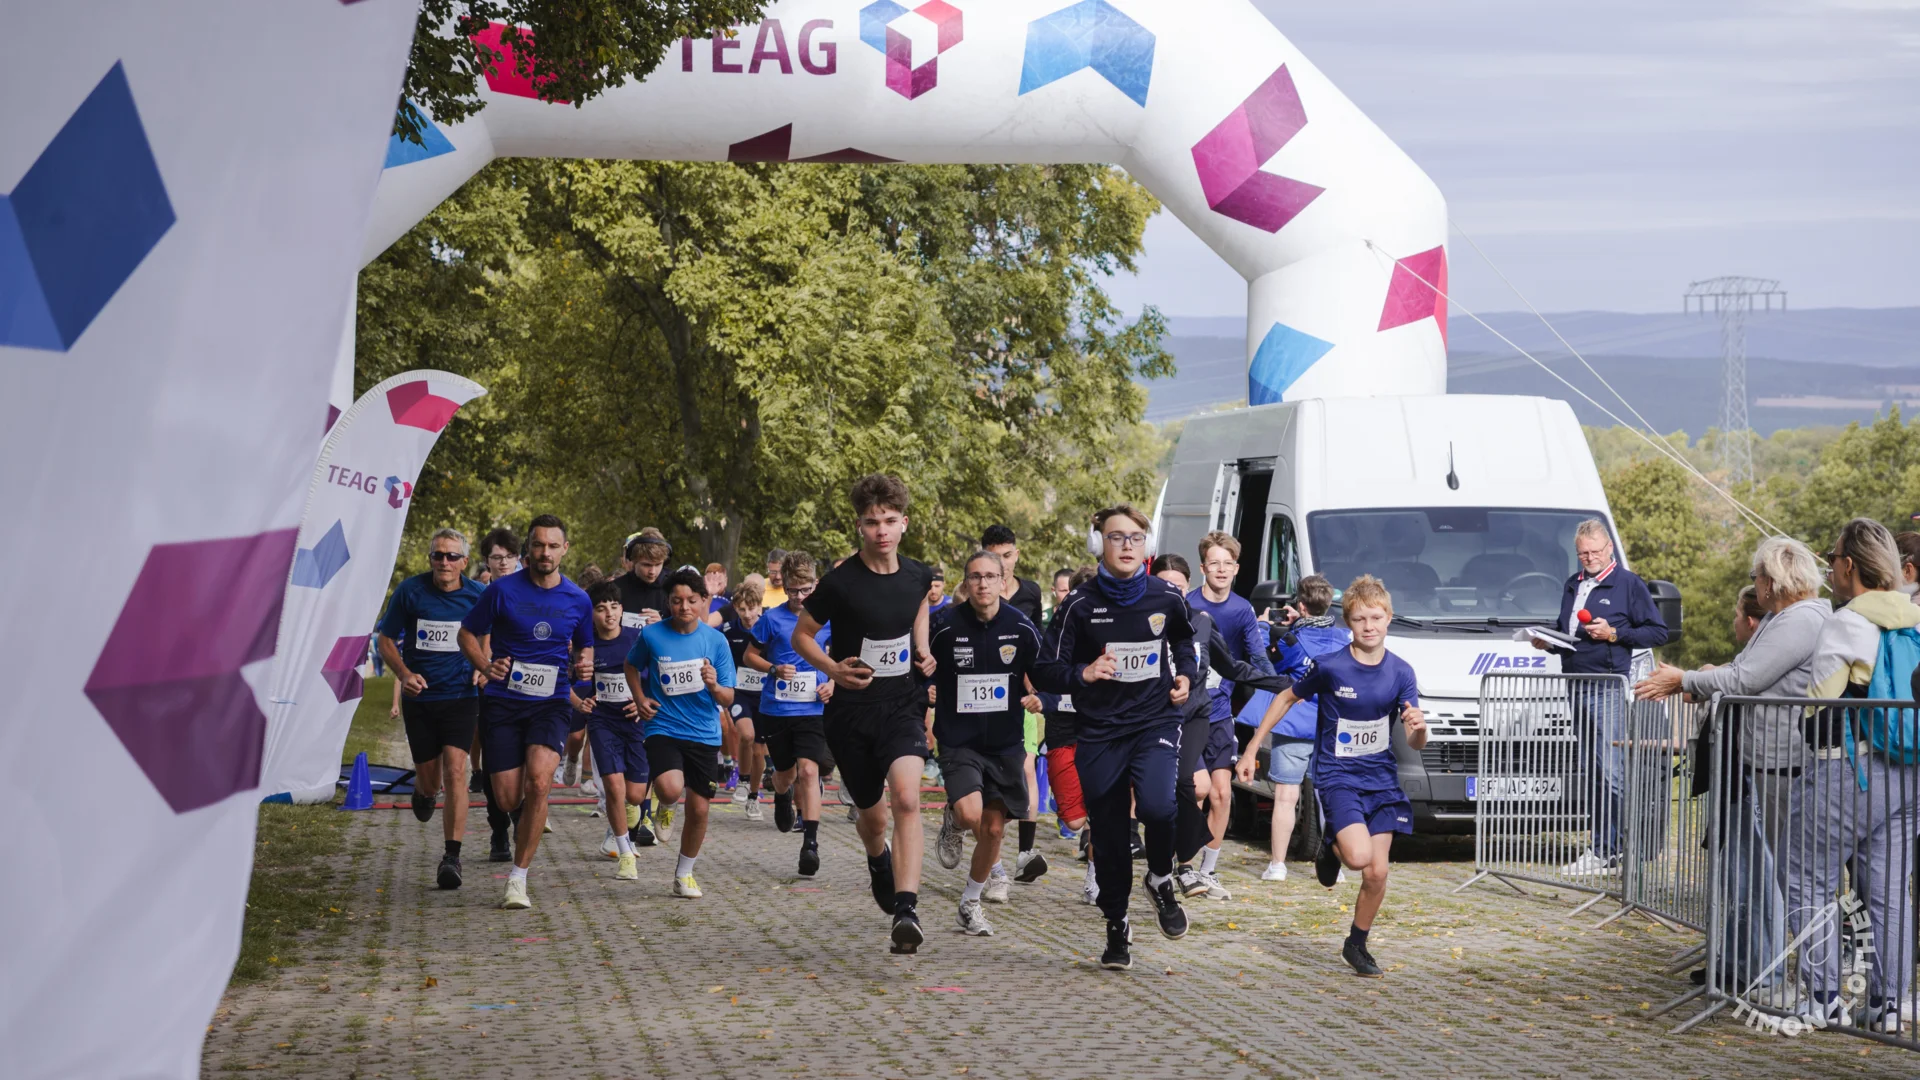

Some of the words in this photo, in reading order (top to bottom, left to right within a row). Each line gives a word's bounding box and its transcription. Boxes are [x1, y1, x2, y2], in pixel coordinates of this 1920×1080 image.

[327, 464, 378, 495] TEAG
[428, 630, 448, 642] 202
[879, 651, 897, 665] 43
[1122, 654, 1148, 670] 107
[1493, 656, 1546, 668] ABZ
[523, 673, 545, 686] 260
[672, 670, 693, 684] 186
[744, 674, 760, 685] 263
[605, 682, 625, 693] 176
[787, 681, 806, 692] 192
[972, 686, 993, 700] 131
[1353, 731, 1378, 745] 106
